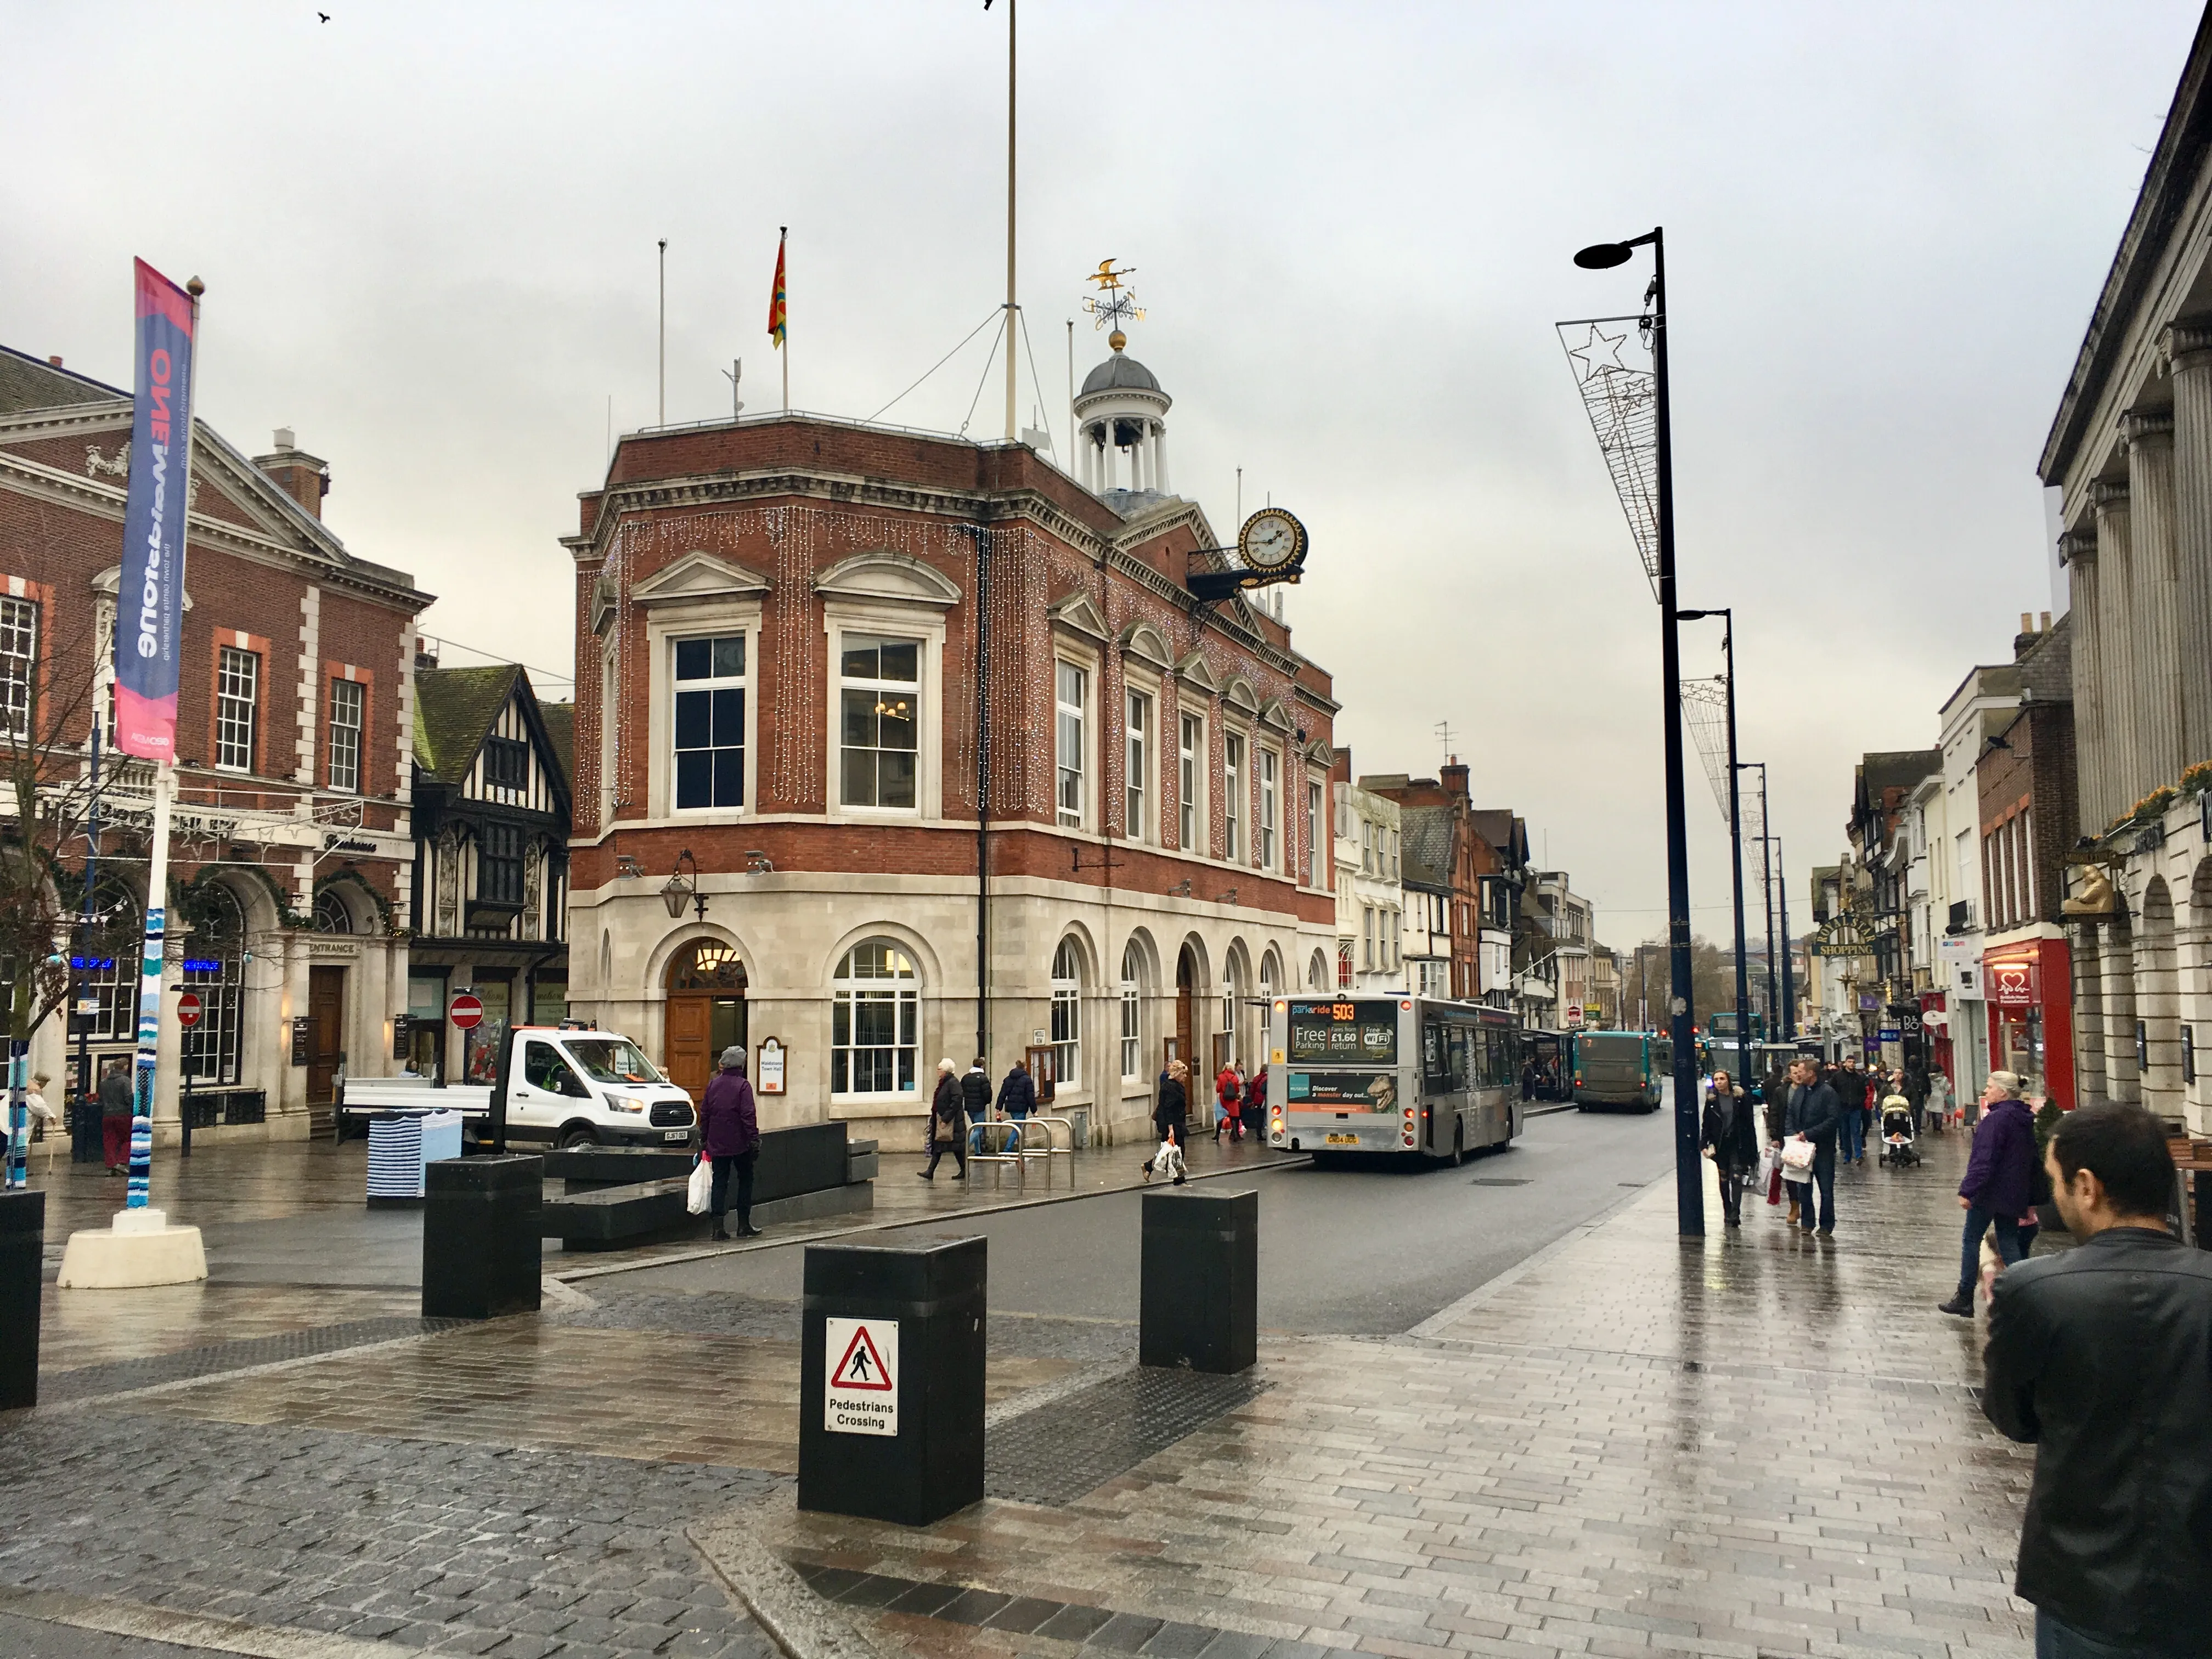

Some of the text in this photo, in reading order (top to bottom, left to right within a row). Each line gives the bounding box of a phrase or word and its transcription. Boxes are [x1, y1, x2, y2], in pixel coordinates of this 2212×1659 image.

[1817, 916, 1876, 943] ROYAL STAR
[309, 944, 355, 953] ENTRANCE
[1820, 945, 1874, 955] SHOPPING
[1333, 1004, 1354, 1020] 503
[1296, 1027, 1326, 1041] Free
[1331, 1033, 1357, 1042] £1.60
[1295, 1041, 1325, 1051] Parking
[1587, 1039, 1592, 1047] 7
[830, 1398, 894, 1414] Pedestrians
[837, 1413, 885, 1430] Crossing
